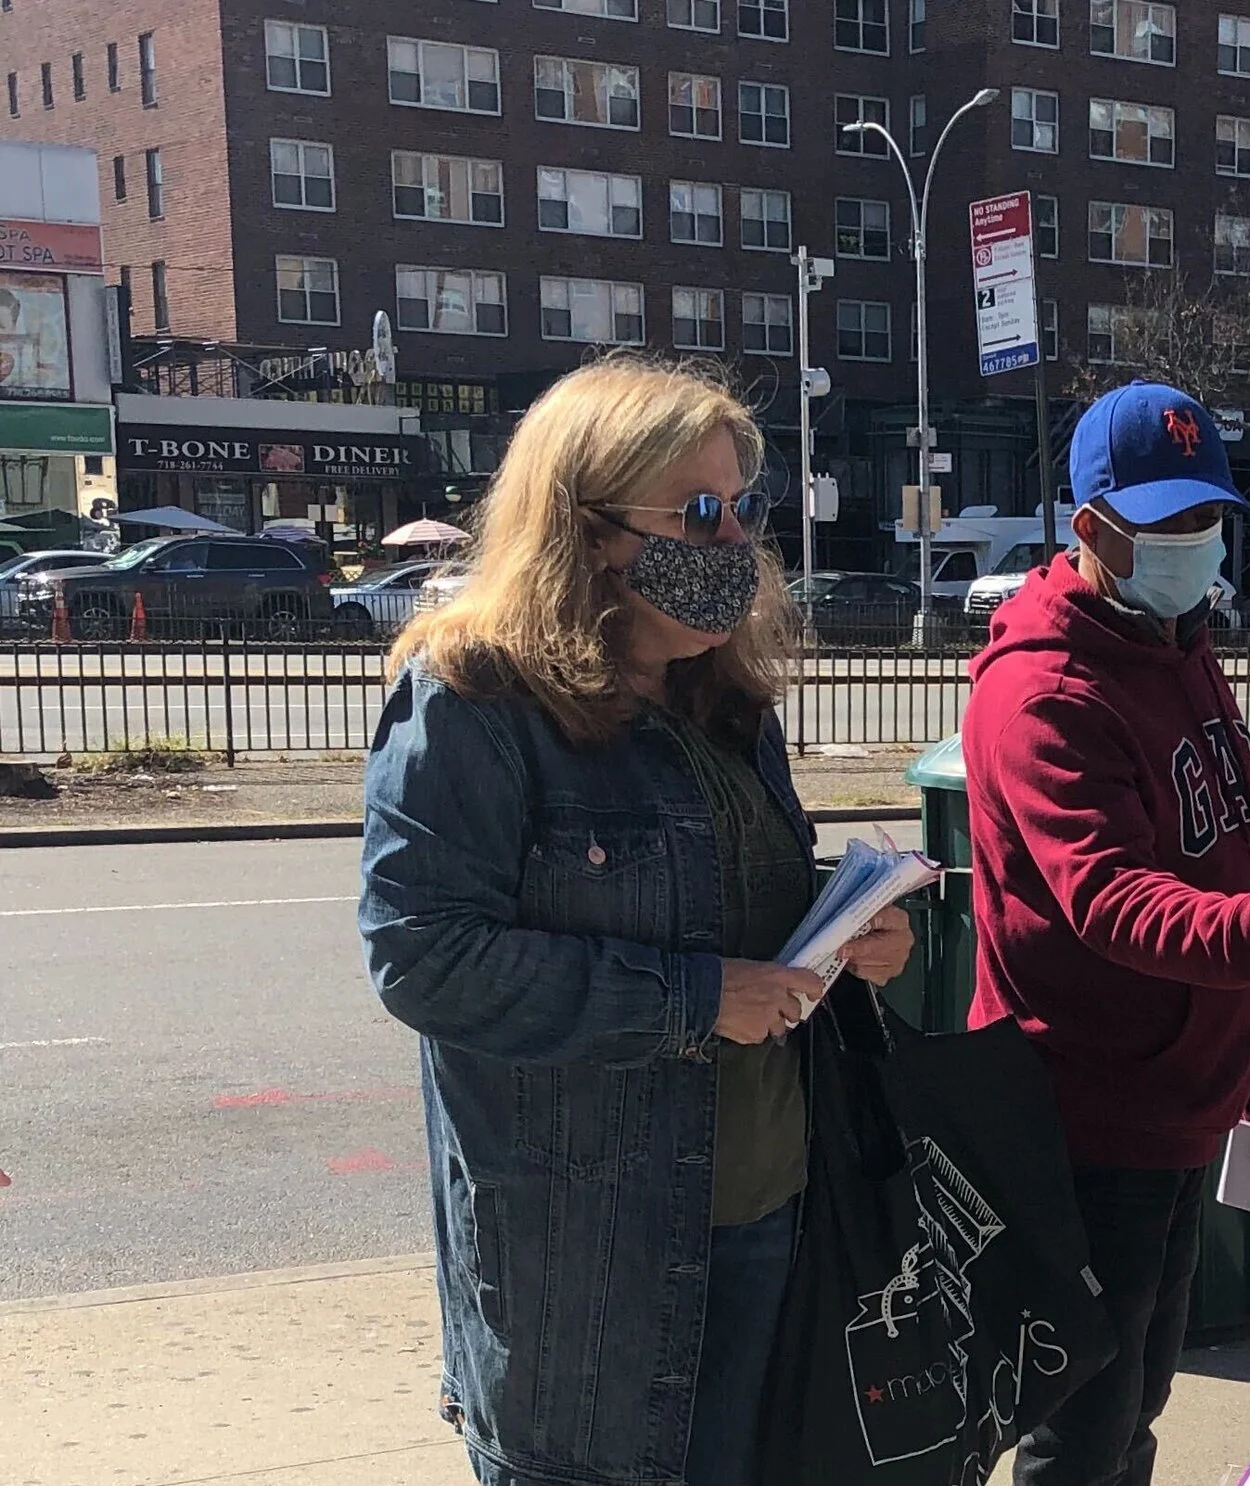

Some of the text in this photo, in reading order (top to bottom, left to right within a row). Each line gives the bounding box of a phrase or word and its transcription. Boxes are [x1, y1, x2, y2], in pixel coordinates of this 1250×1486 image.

[973, 198, 1020, 216] NO STANDING
[974, 214, 1003, 226] Anytime
[22, 246, 55, 264] SPA
[981, 289, 992, 307] 2
[128, 438, 412, 466] T-BONE DINER
[325, 465, 400, 476] FREE DELIVERY
